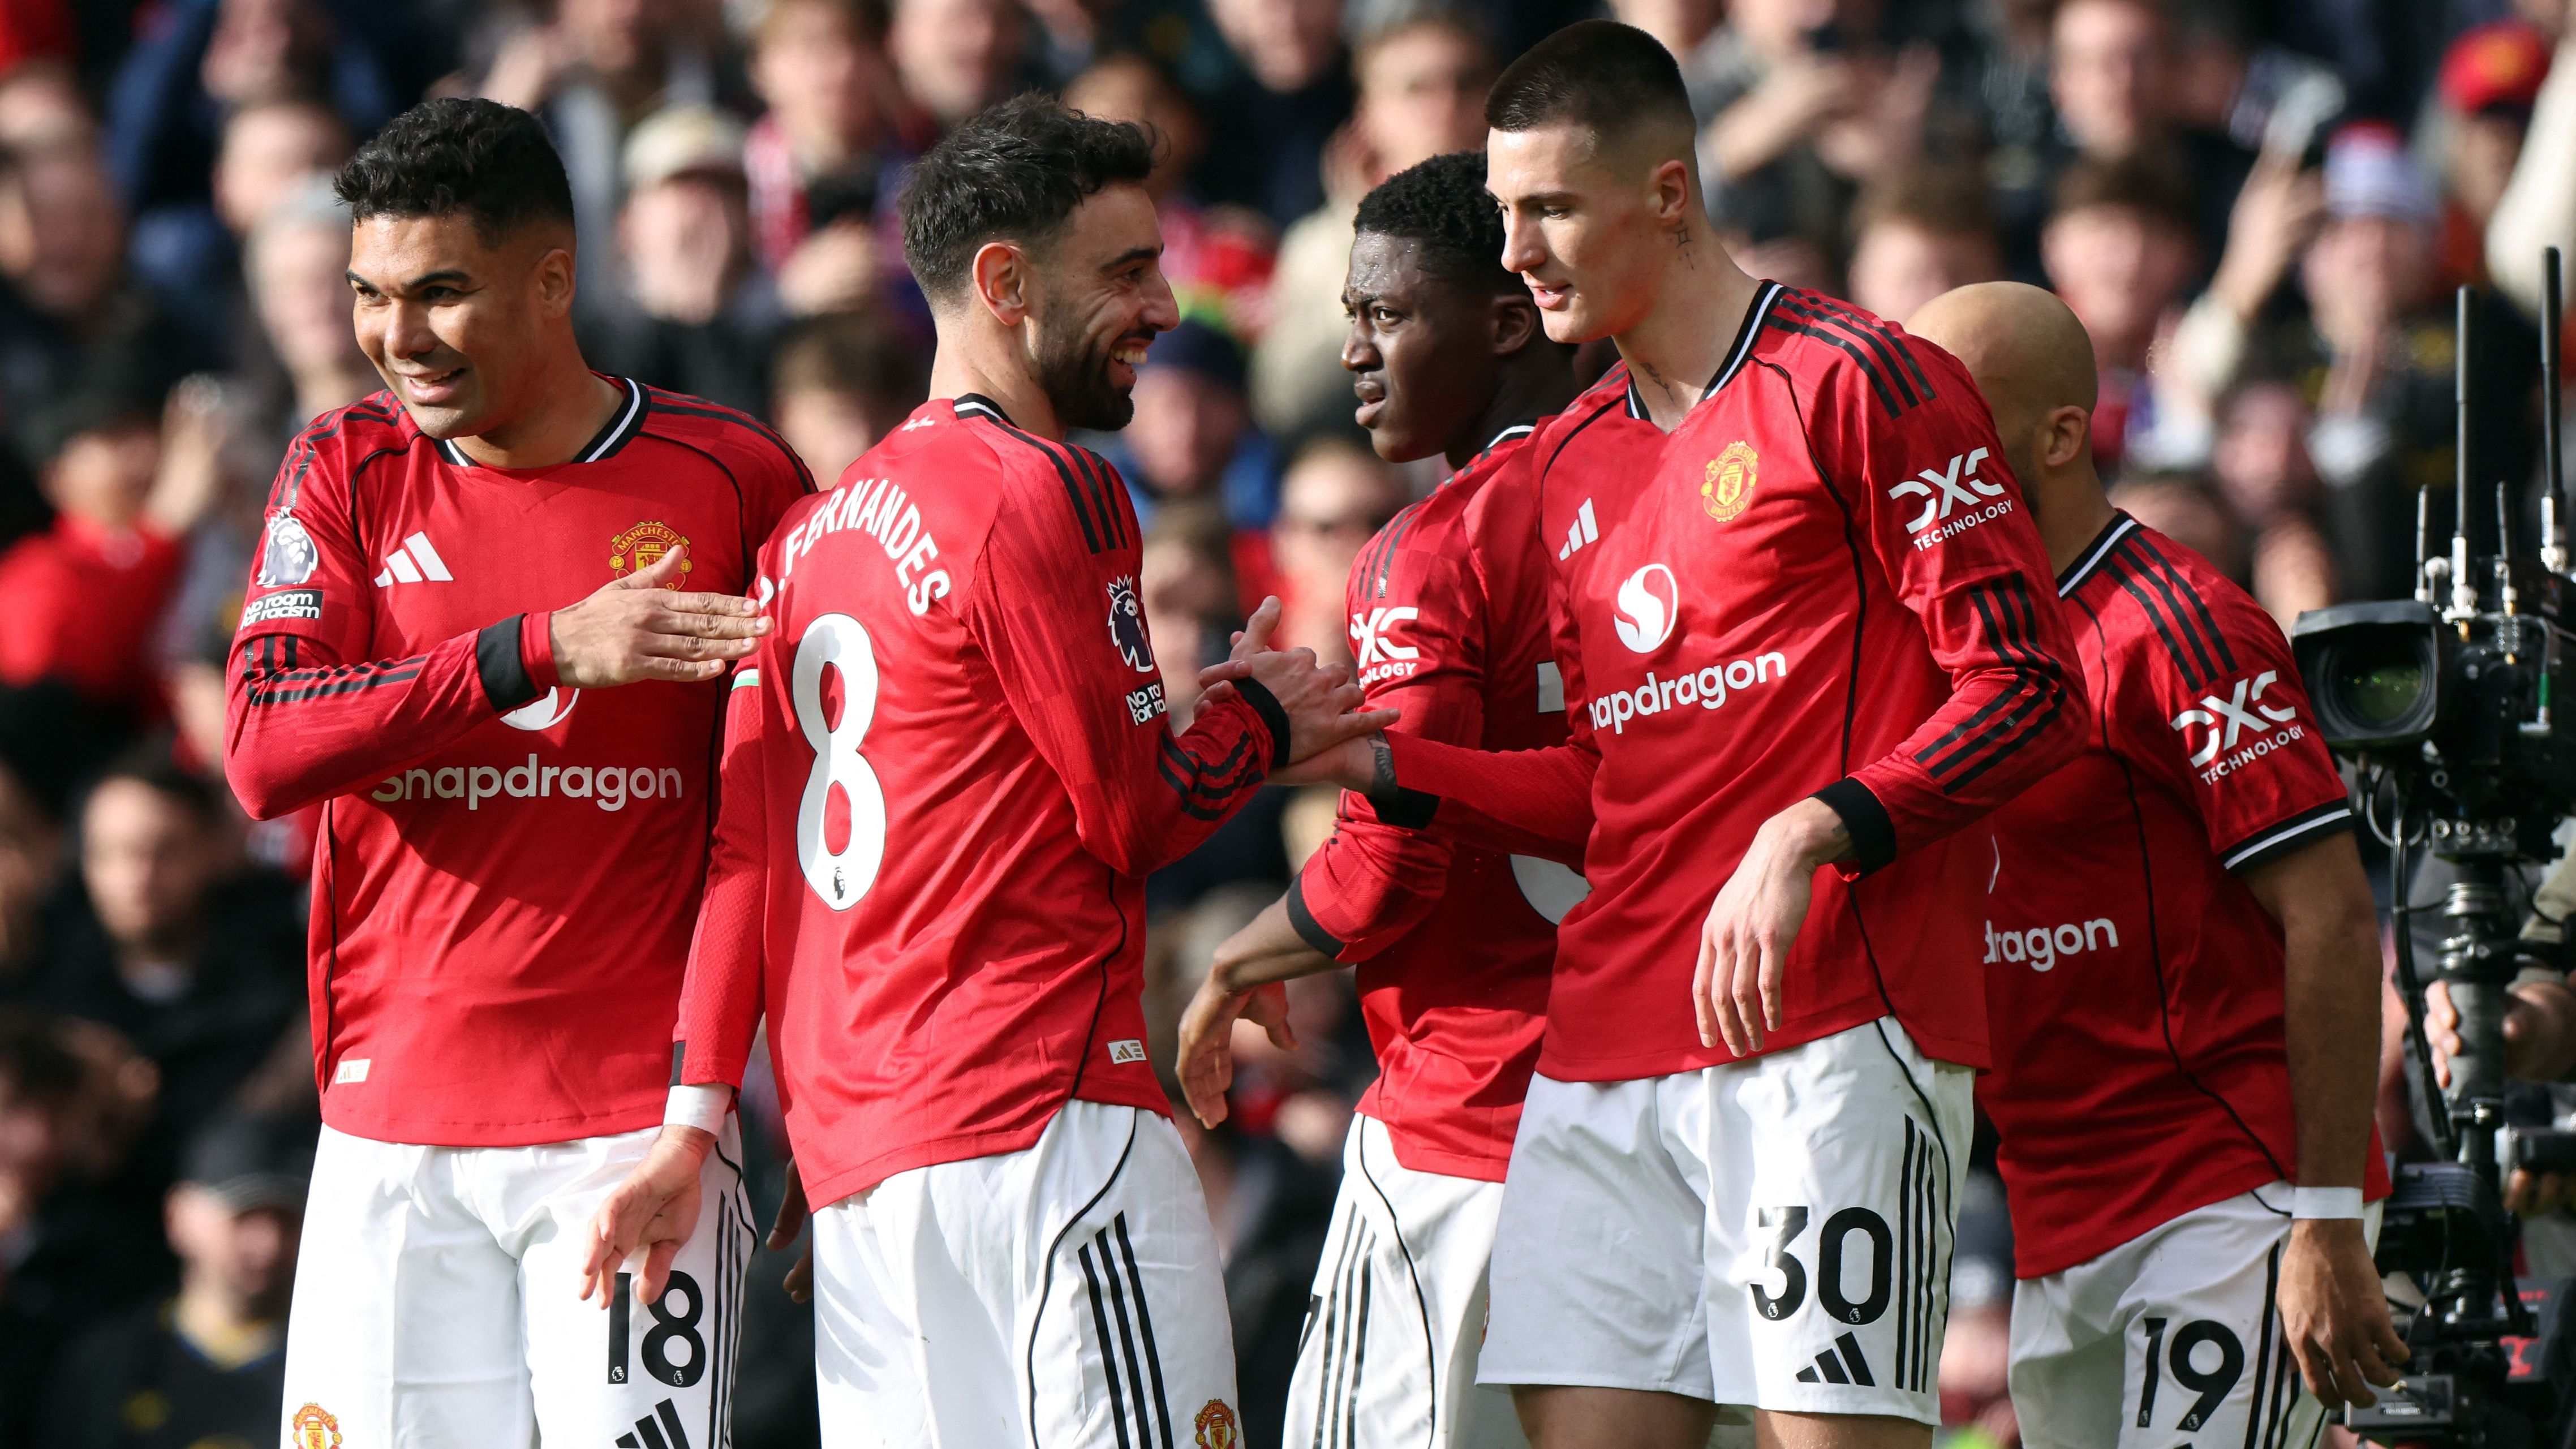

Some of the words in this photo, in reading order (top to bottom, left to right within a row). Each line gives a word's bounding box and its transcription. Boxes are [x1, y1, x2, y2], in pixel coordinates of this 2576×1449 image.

[1710, 501, 1744, 515] UNITED
[1888, 446, 2005, 534] DXC
[617, 527, 679, 550] MANCHESTE
[785, 478, 951, 616] FERNANDES
[1913, 500, 2012, 552] TECHNOLOGY
[244, 601, 263, 616] No
[264, 594, 313, 609] room
[260, 606, 320, 620] racism
[1350, 607, 1420, 669] XC
[1125, 691, 1147, 712] No
[1147, 683, 1161, 699] ro
[1132, 704, 1152, 726] for
[2170, 670, 2296, 768] DXC
[372, 753, 682, 811] Snapdragon
[792, 613, 887, 911] 8
[2200, 725, 2304, 785] TECHNOLOGY
[1750, 1206, 1893, 1325] 30
[608, 1270, 706, 1388] 18
[2136, 1317, 2245, 1432] 19
